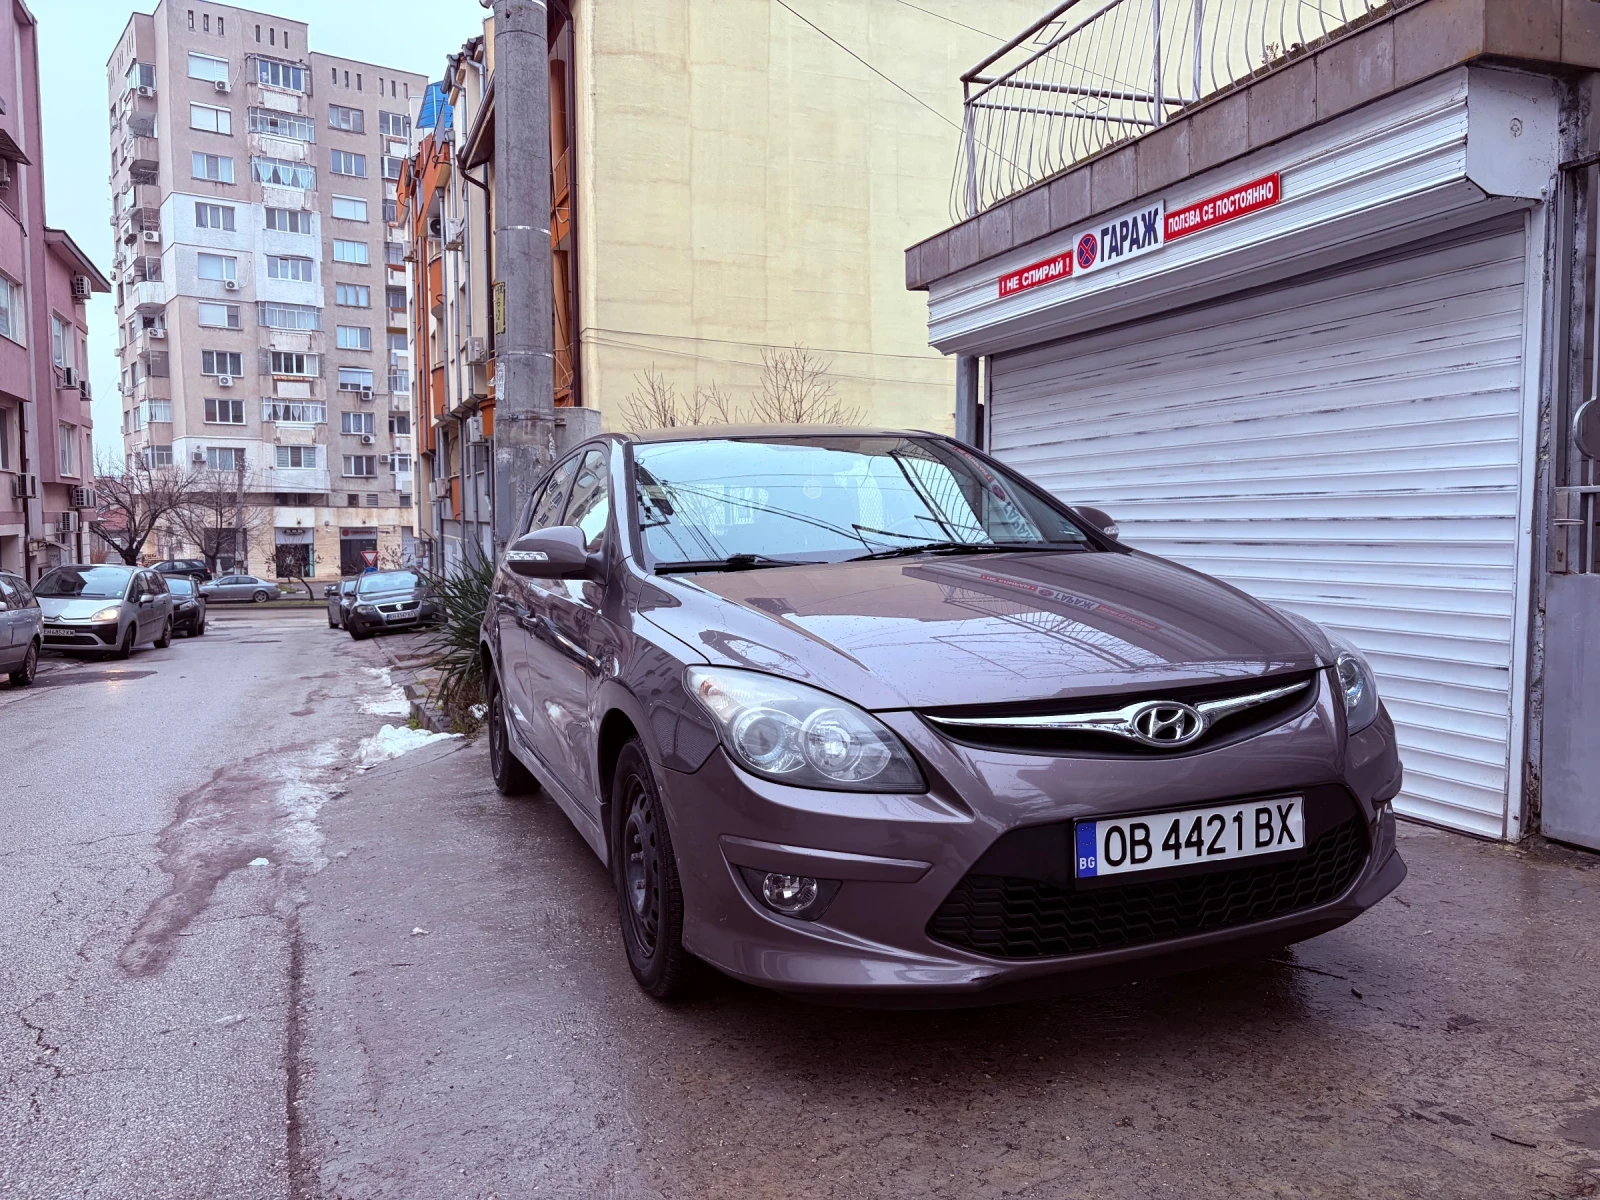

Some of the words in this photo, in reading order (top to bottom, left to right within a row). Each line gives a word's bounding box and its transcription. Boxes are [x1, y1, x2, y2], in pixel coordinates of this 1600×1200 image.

[1168, 208, 1200, 234] ПОЛЗВА
[1202, 203, 1214, 222] СЕ
[1216, 181, 1274, 217] ПОСТОЯННО
[1100, 207, 1159, 263] ГАРАЖ
[1006, 275, 1020, 291] НЕ
[1022, 257, 1063, 286] СПИРАЙ
[1104, 822, 1152, 867] OB
[1162, 810, 1243, 860] 4421
[1255, 803, 1296, 849] BX
[1079, 856, 1095, 870] BG
